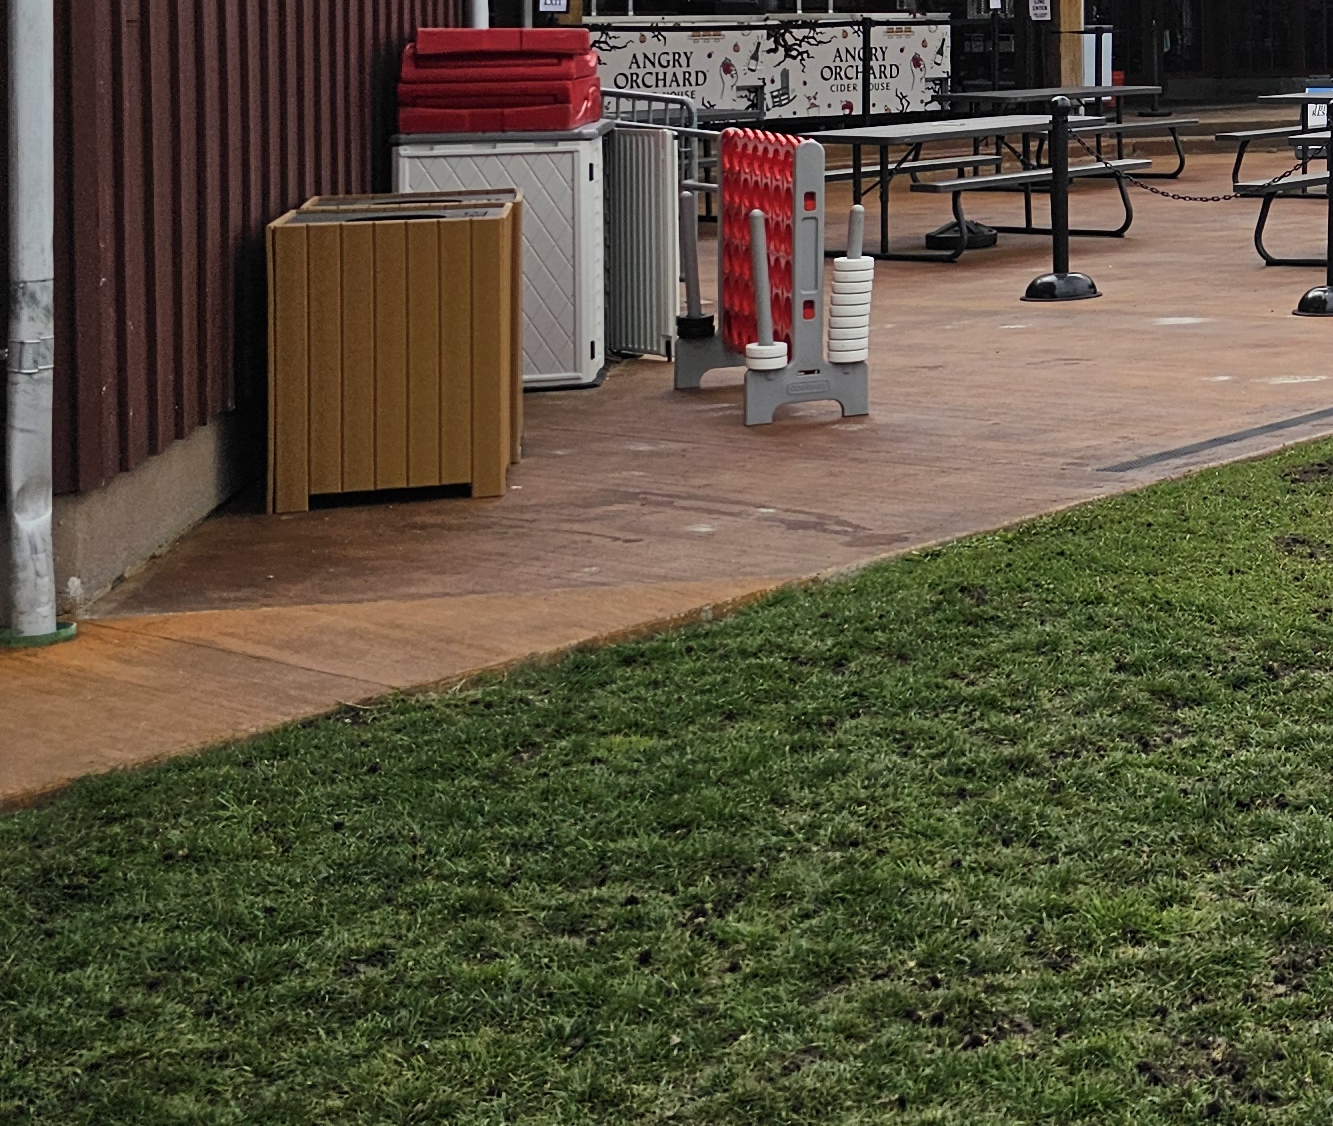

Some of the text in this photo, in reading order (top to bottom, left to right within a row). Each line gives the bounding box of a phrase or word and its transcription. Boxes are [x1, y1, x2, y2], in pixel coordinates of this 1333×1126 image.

[629, 51, 693, 70] ANGRY
[614, 70, 707, 89] ORCHARD
[830, 82, 890, 93] CIDER OUSE
